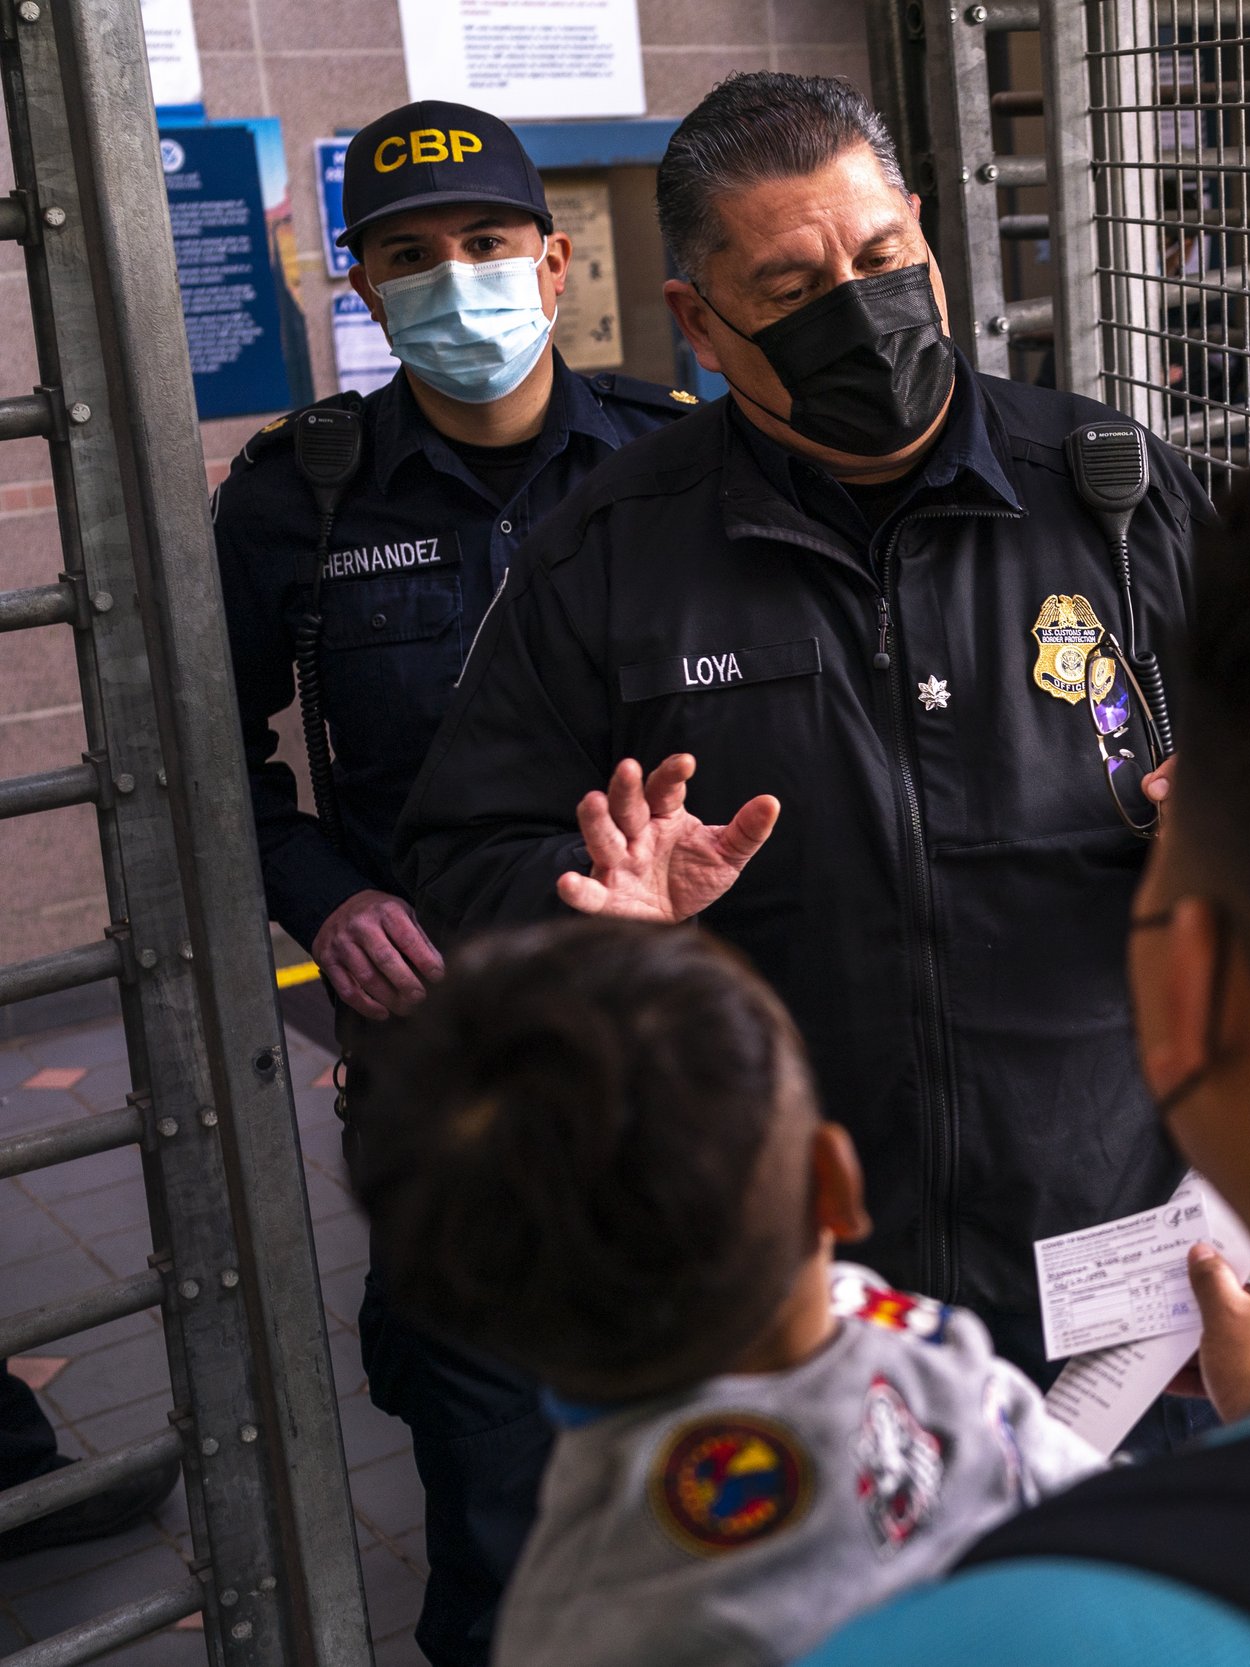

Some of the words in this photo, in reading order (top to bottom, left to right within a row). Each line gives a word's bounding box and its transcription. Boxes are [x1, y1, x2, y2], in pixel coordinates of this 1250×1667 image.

[374, 128, 482, 173] CBP
[322, 537, 441, 579] HERNANDEZ
[1042, 635, 1064, 643] BORDER
[1064, 635, 1096, 643] PROTECTION
[682, 652, 743, 686] LOYA
